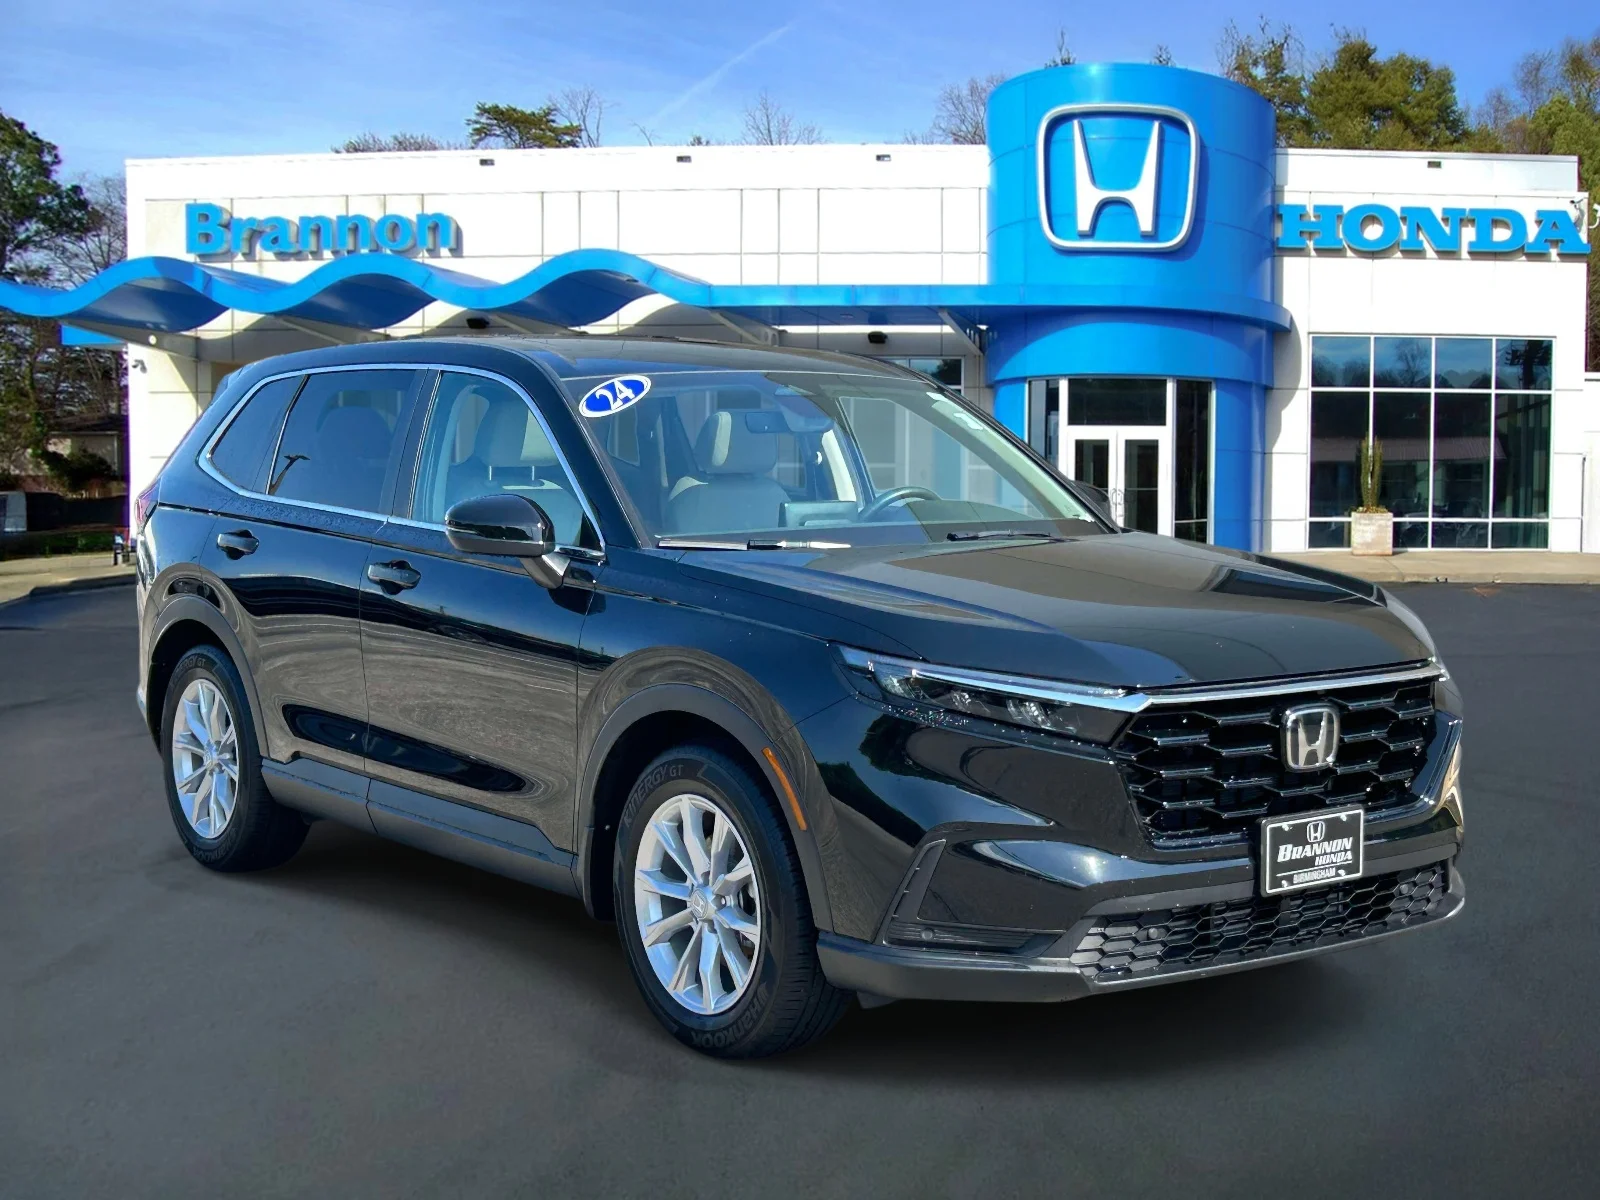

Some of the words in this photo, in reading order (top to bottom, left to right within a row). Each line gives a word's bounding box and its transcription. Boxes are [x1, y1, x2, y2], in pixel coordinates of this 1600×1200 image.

[185, 203, 456, 254] Brannon
[1276, 203, 1591, 254] HONDA
[595, 380, 635, 411] 24
[669, 764, 684, 778] GT
[1277, 837, 1353, 862] BRANNON
[1314, 850, 1353, 866] HONDA
